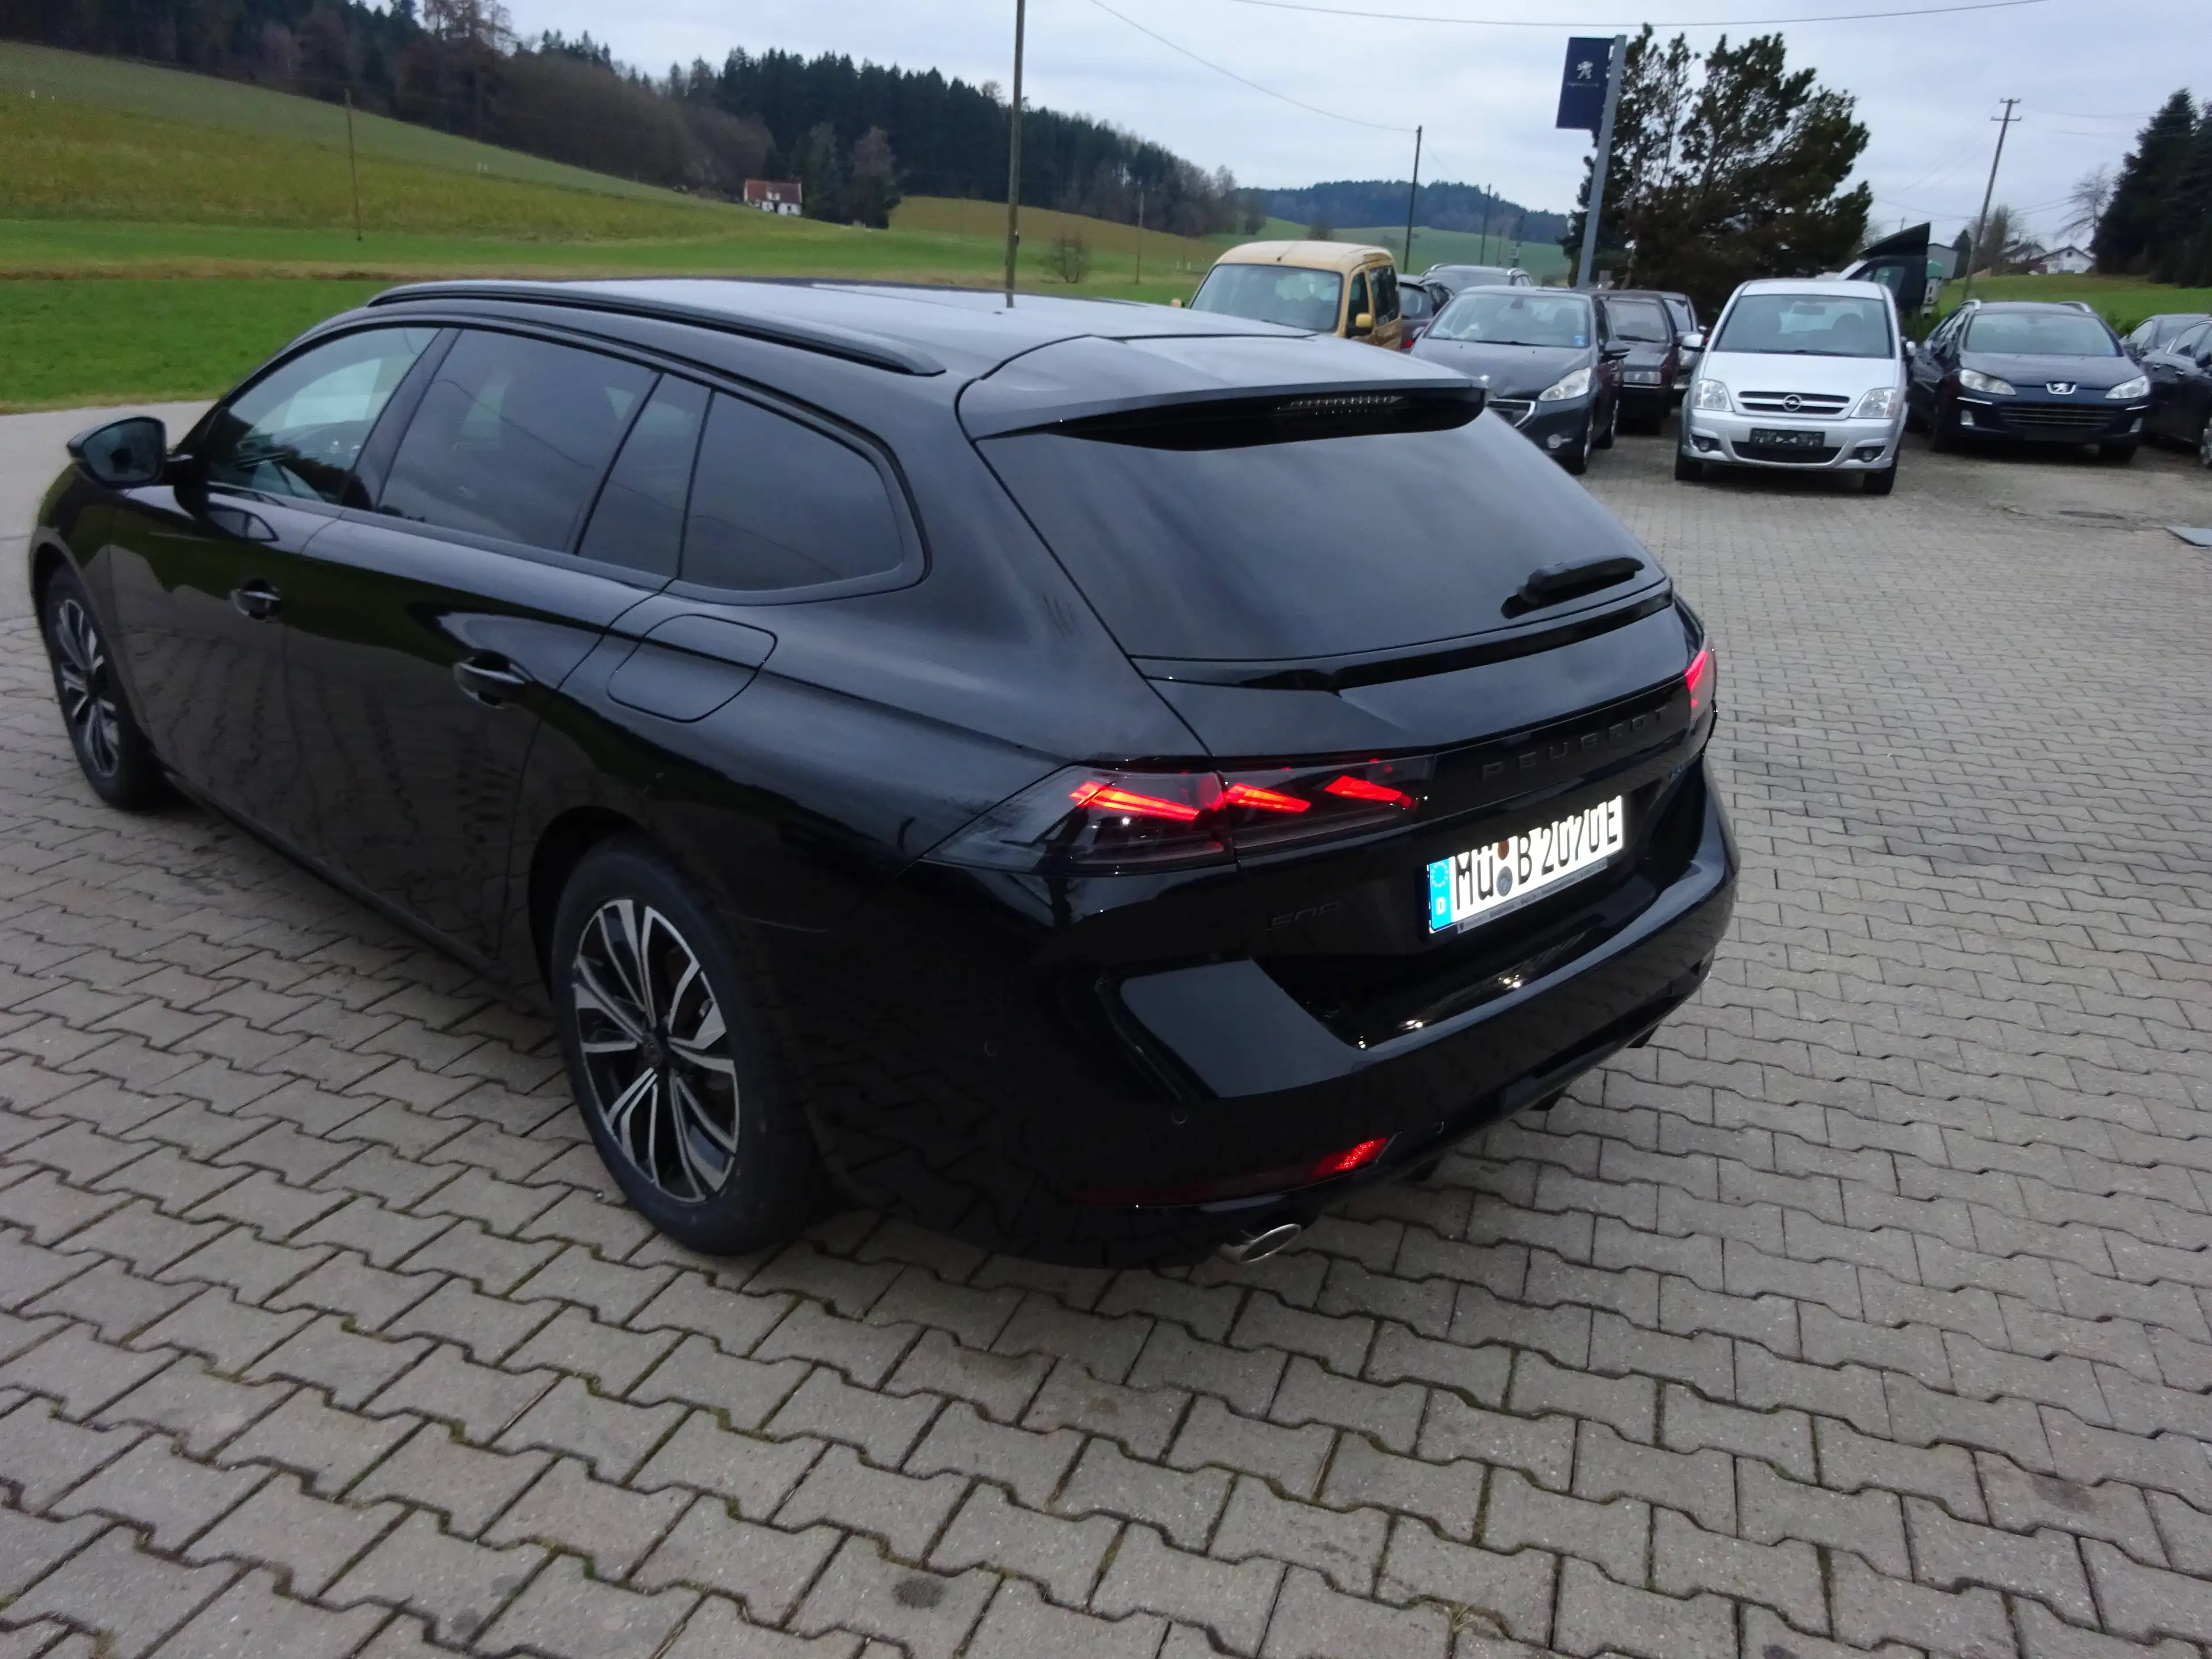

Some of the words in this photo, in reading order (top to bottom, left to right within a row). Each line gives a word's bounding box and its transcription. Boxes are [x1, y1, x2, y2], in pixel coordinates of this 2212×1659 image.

[1482, 706, 1667, 779] PEUGEOT
[1517, 832, 1532, 886] B
[1541, 796, 1619, 876] 2070E
[1435, 896, 1446, 915] D
